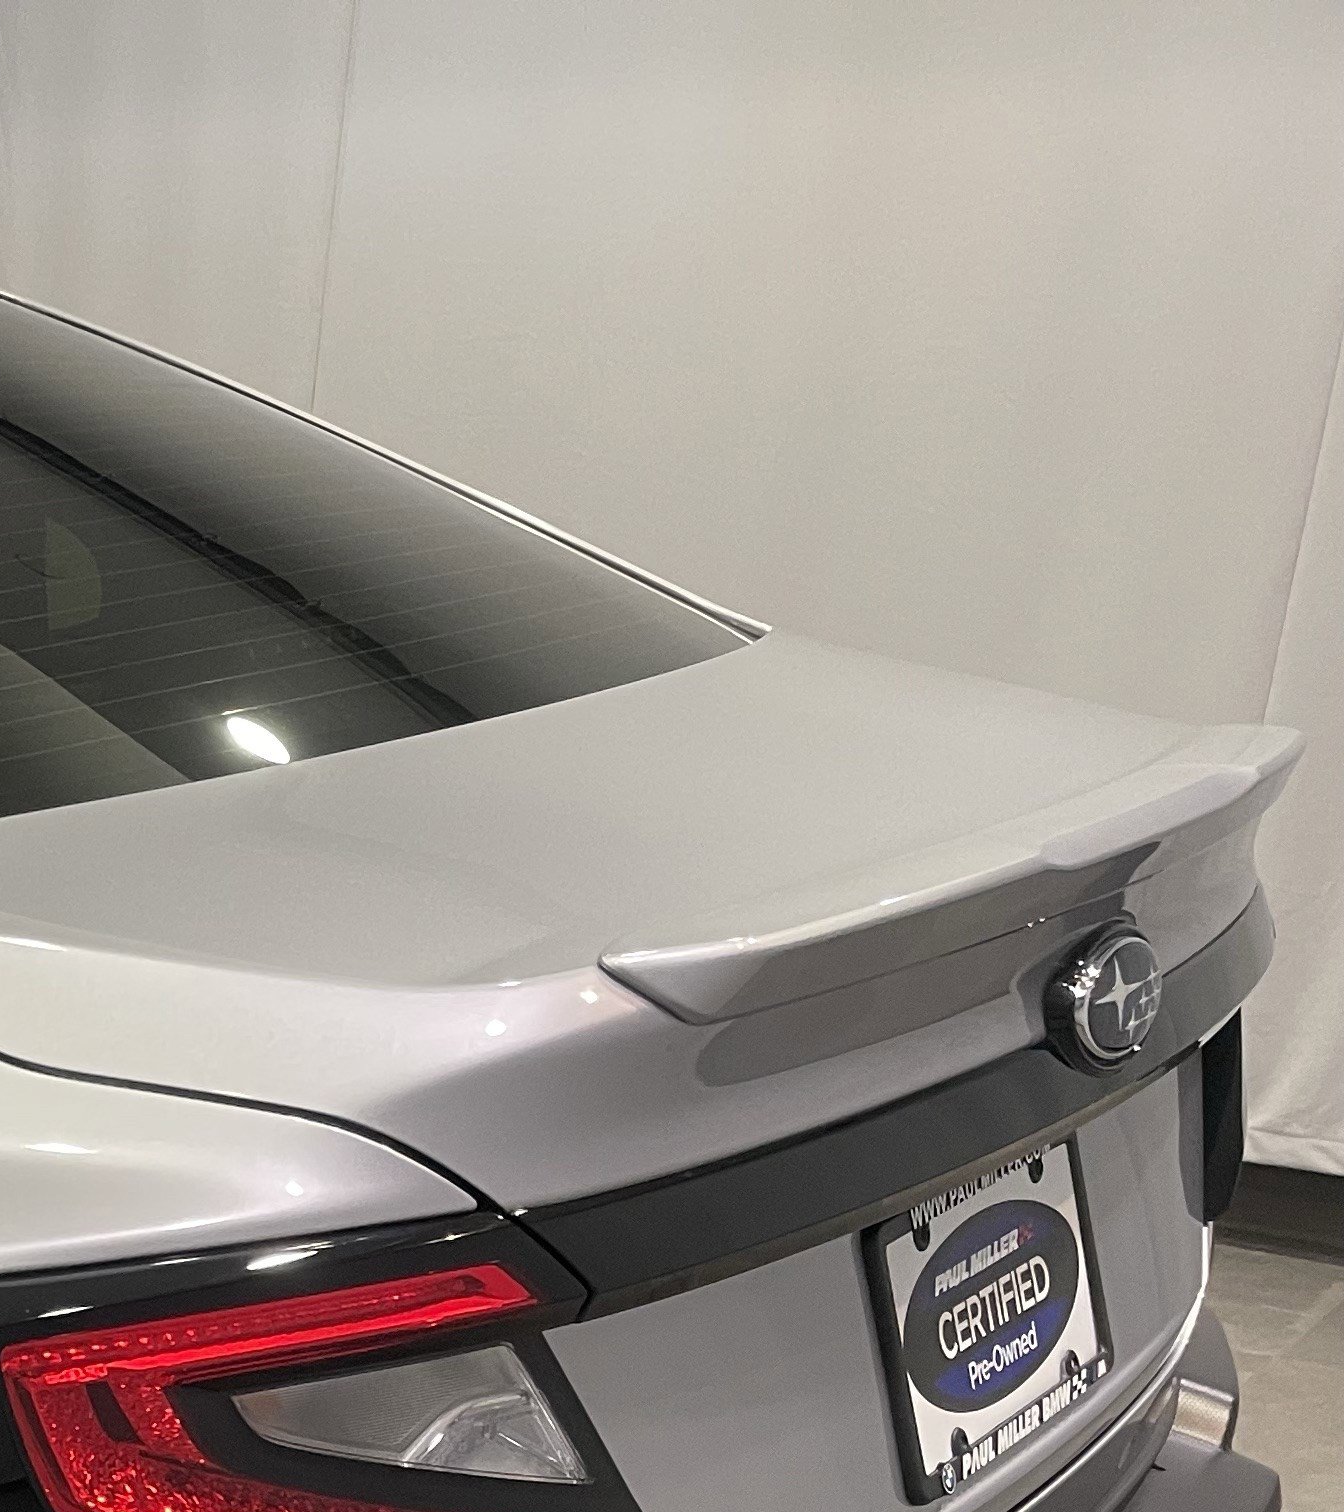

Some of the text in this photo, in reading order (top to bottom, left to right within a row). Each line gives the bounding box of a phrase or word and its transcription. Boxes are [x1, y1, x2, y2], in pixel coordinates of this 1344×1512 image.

[935, 1230, 1019, 1297] PAUL MILLER
[938, 1255, 1050, 1359] CERTIFIED
[968, 1322, 1038, 1390] Pre-Owned
[962, 1380, 1071, 1480] PAUL MILLER BMW
